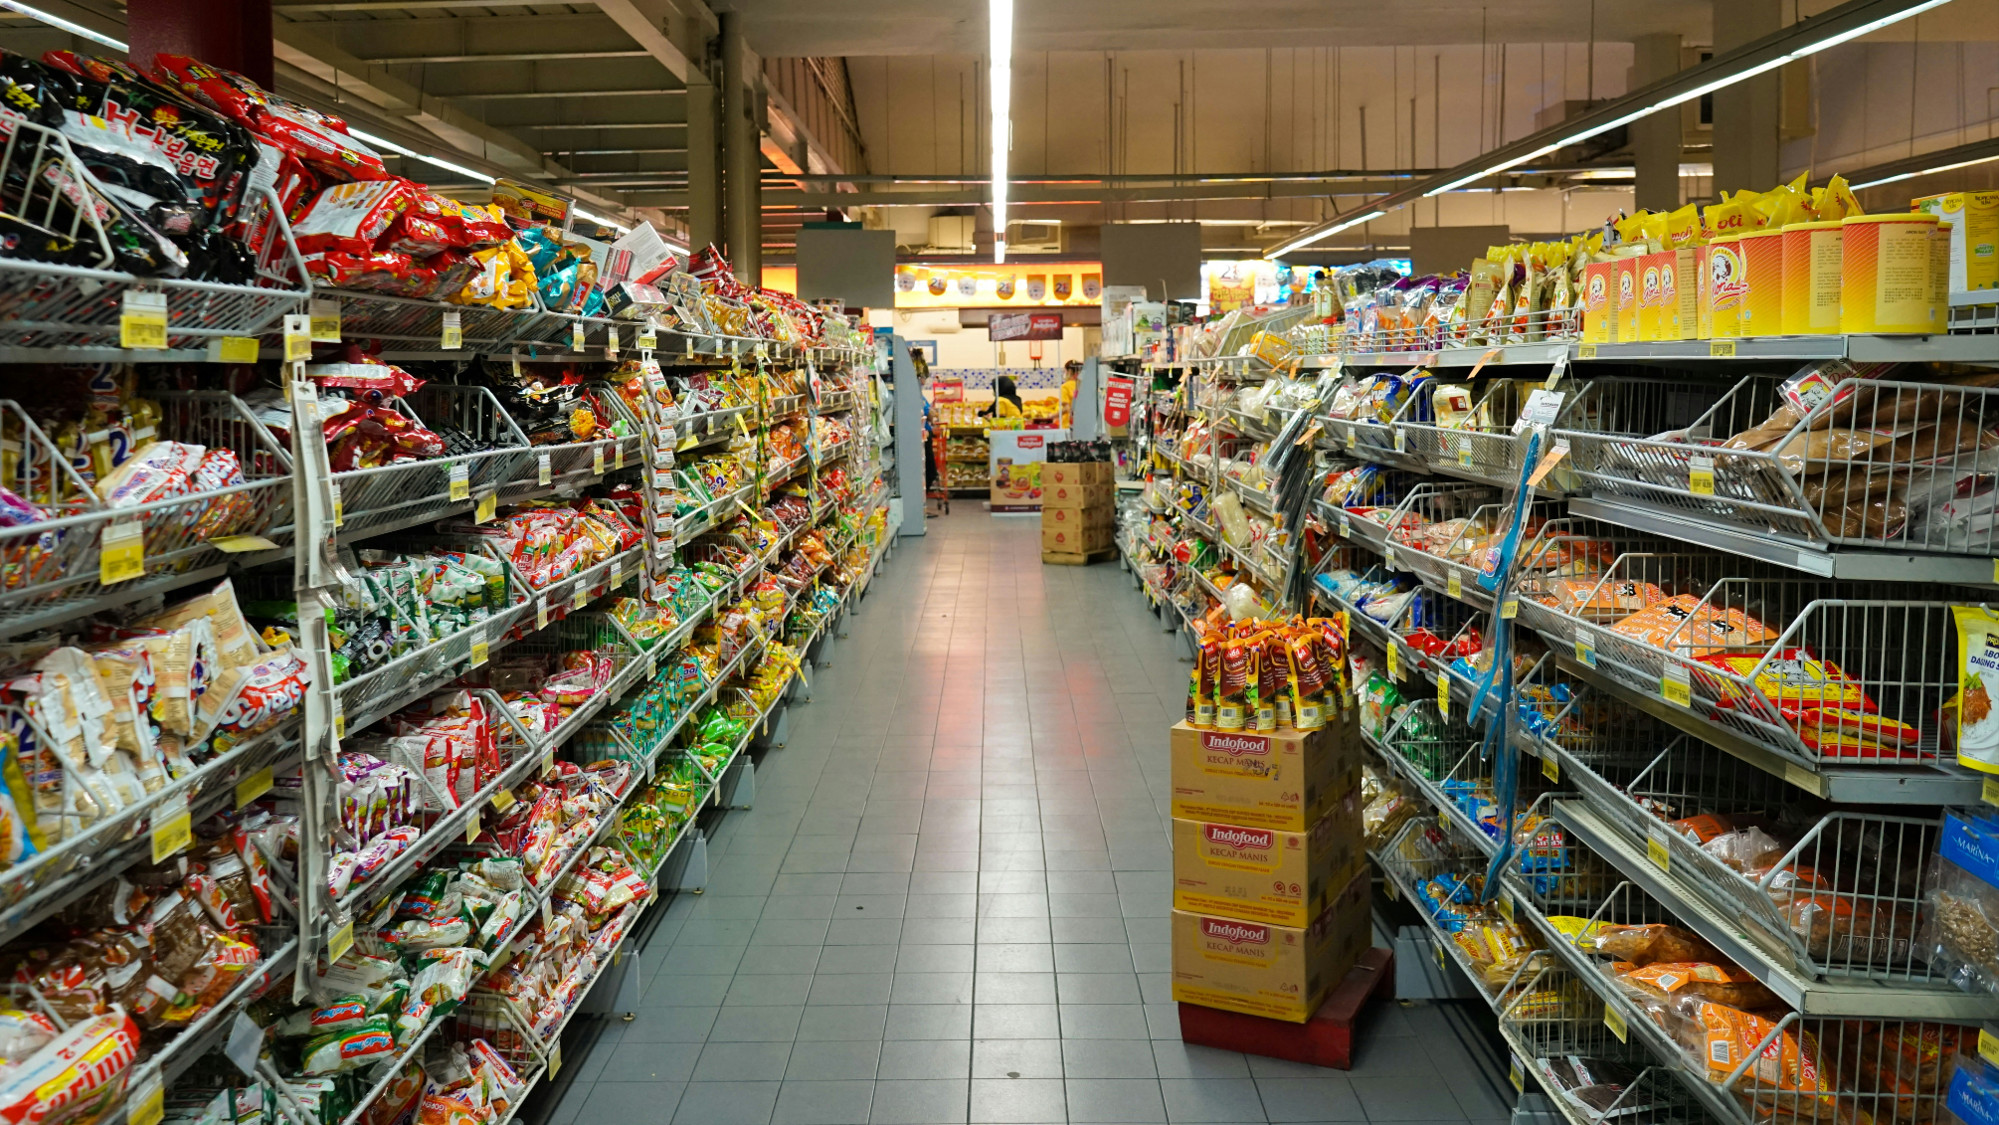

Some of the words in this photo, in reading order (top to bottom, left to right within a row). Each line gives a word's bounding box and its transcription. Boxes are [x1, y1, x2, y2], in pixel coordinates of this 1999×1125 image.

[1208, 735, 1266, 753] Indofood
[1207, 755, 1234, 765] KECAP
[1212, 828, 1269, 846] Indofood
[1210, 847, 1238, 858] KECAP
[1239, 850, 1268, 862] MANIS
[1952, 835, 1995, 863] MARINA
[1208, 922, 1265, 940] Indofood
[1206, 941, 1234, 953] KECAP
[1235, 945, 1265, 958] MANIS
[1958, 1089, 1994, 1122] MARINA
